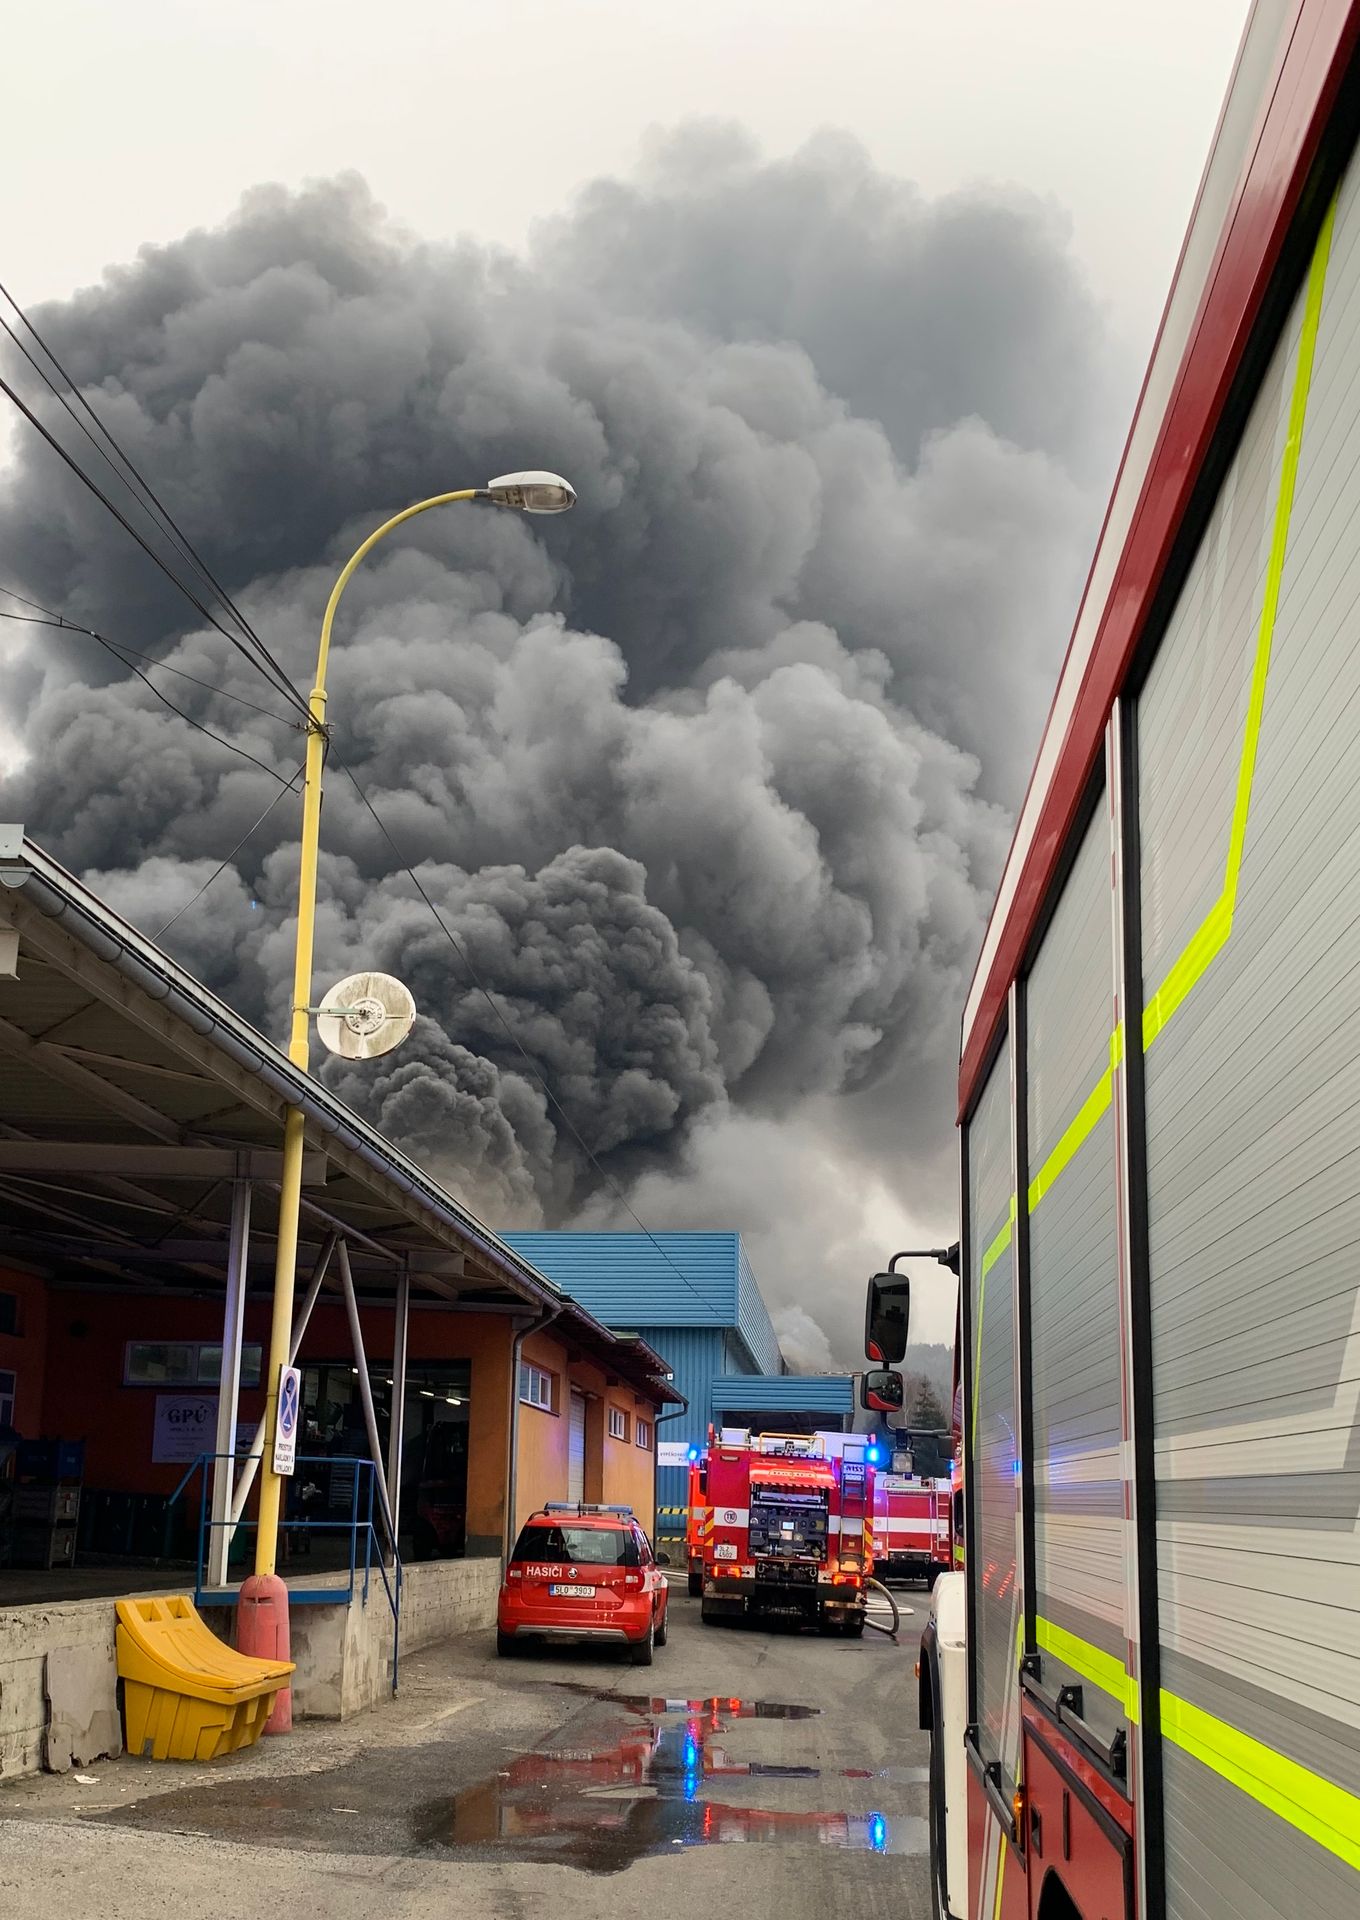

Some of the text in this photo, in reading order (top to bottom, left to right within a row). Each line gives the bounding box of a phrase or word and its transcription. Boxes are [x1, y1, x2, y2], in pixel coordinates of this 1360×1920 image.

[168, 1405, 208, 1423] GPÚ
[526, 1565, 563, 1577] HASIČI
[574, 1587, 592, 1595] 3903
